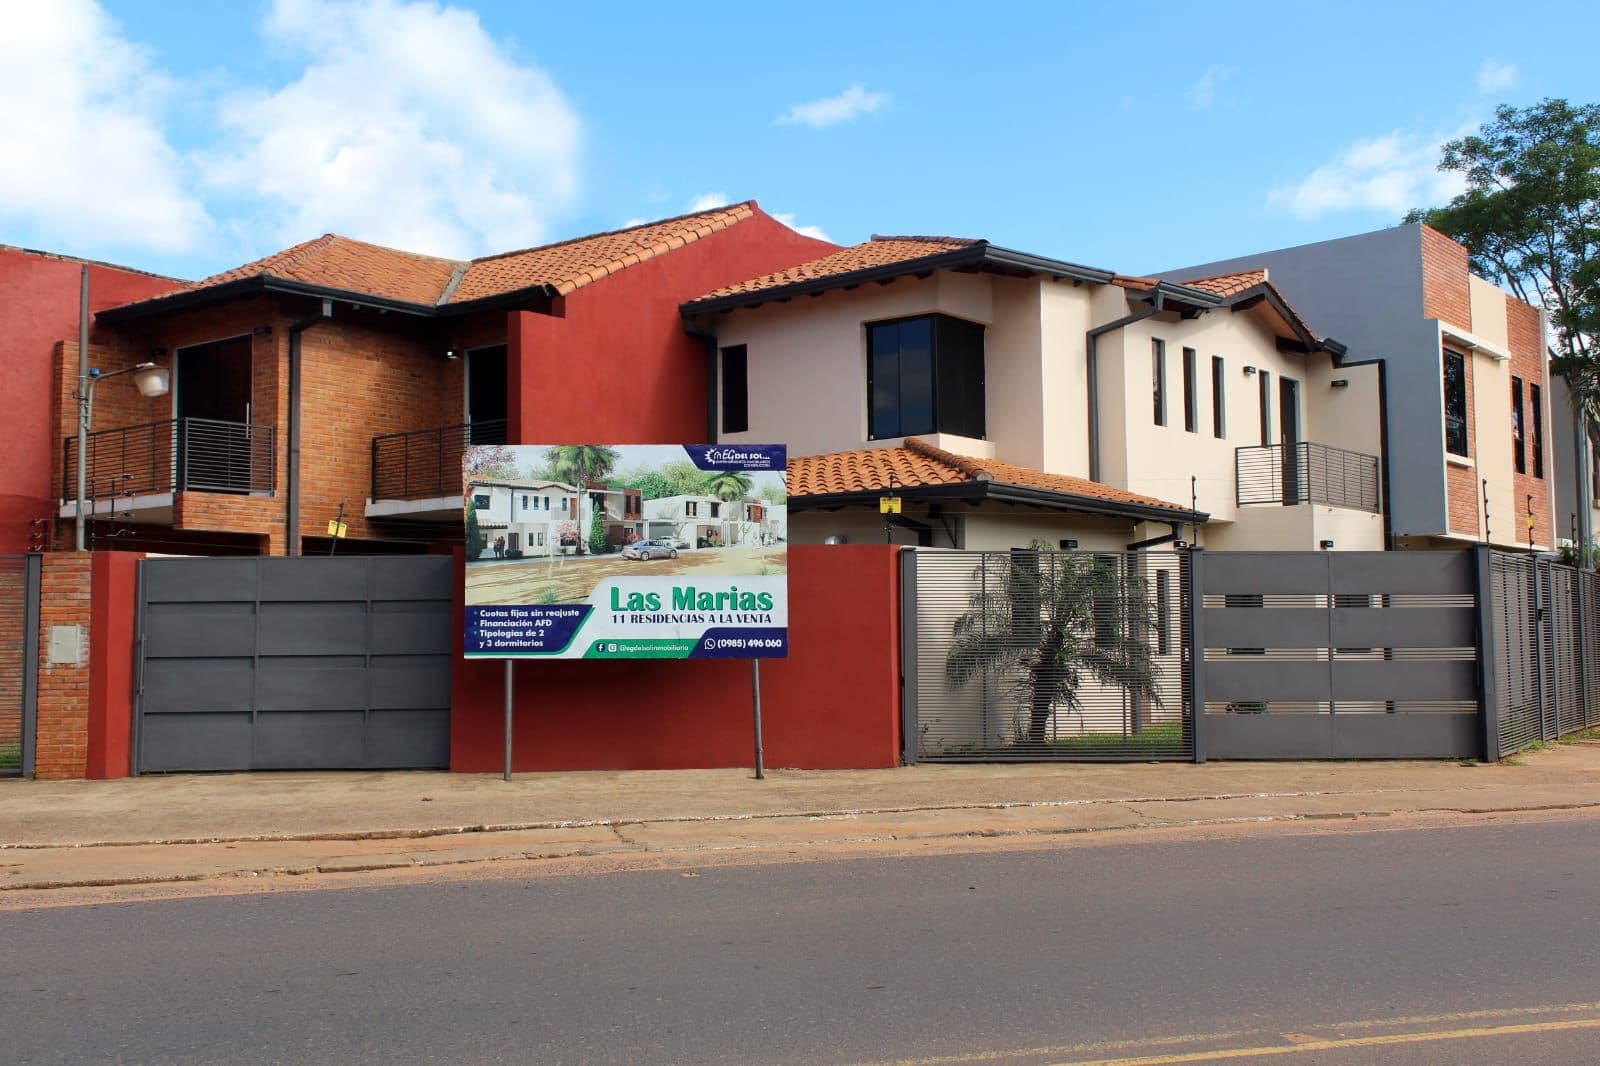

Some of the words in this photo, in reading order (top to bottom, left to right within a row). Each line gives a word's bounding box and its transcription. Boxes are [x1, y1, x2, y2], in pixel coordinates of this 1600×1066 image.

[611, 587, 661, 611] Las
[672, 586, 773, 611] Marias
[480, 609, 508, 617] Cuotas
[511, 609, 528, 618] fijas
[531, 609, 543, 617] sin
[546, 609, 579, 618] reajuste
[480, 619, 532, 627] Financiación
[535, 619, 552, 627] AFD
[612, 614, 625, 624] 11
[631, 614, 705, 624] RESIDENCIAS
[708, 614, 716, 624] A
[719, 614, 732, 624] LA
[736, 614, 772, 623] VENTA
[526, 629, 536, 637] de
[538, 629, 544, 637] 2
[494, 639, 544, 647] dormitorios
[717, 638, 746, 649] (0985)
[748, 639, 764, 648] 496
[765, 639, 782, 648] 060
